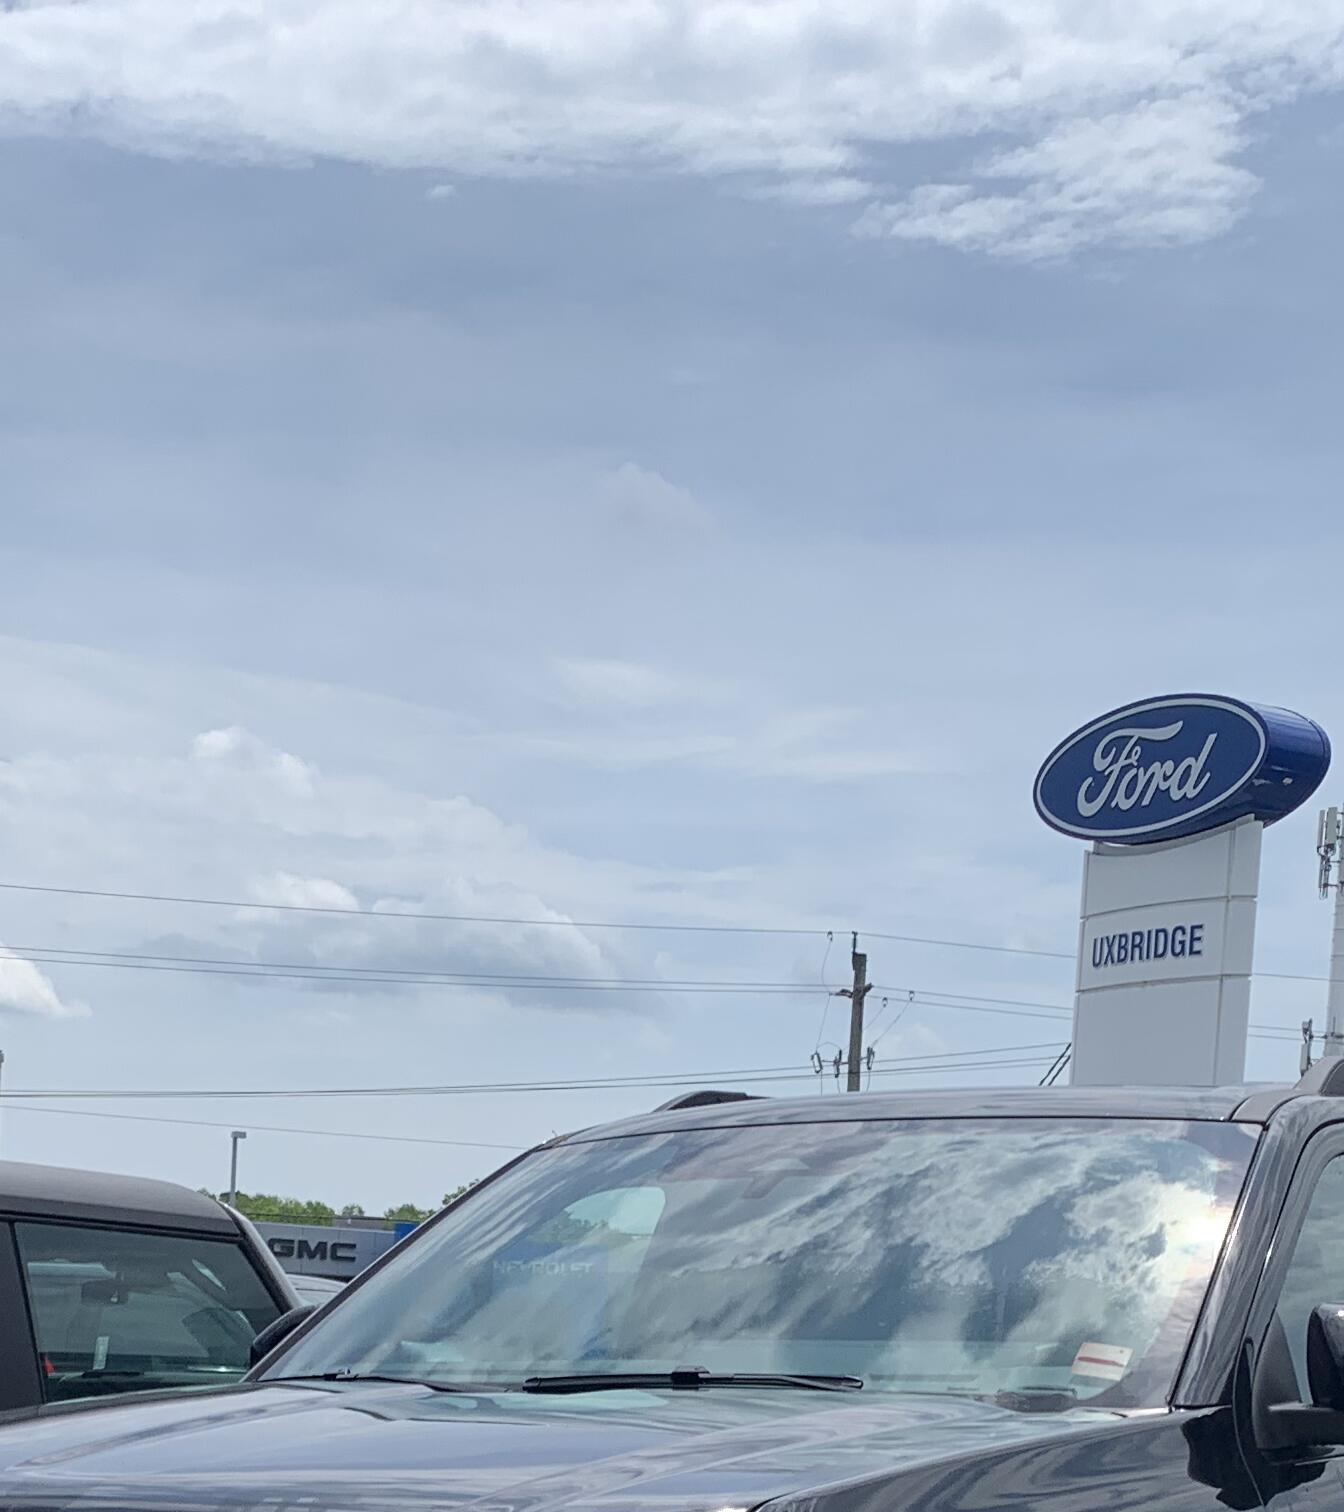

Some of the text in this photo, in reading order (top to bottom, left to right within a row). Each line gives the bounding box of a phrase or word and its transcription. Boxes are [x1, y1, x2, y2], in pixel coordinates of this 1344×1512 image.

[1077, 720, 1217, 817] Ford
[1091, 924, 1204, 967] UXBRIDGE
[267, 1237, 357, 1263] GMC
